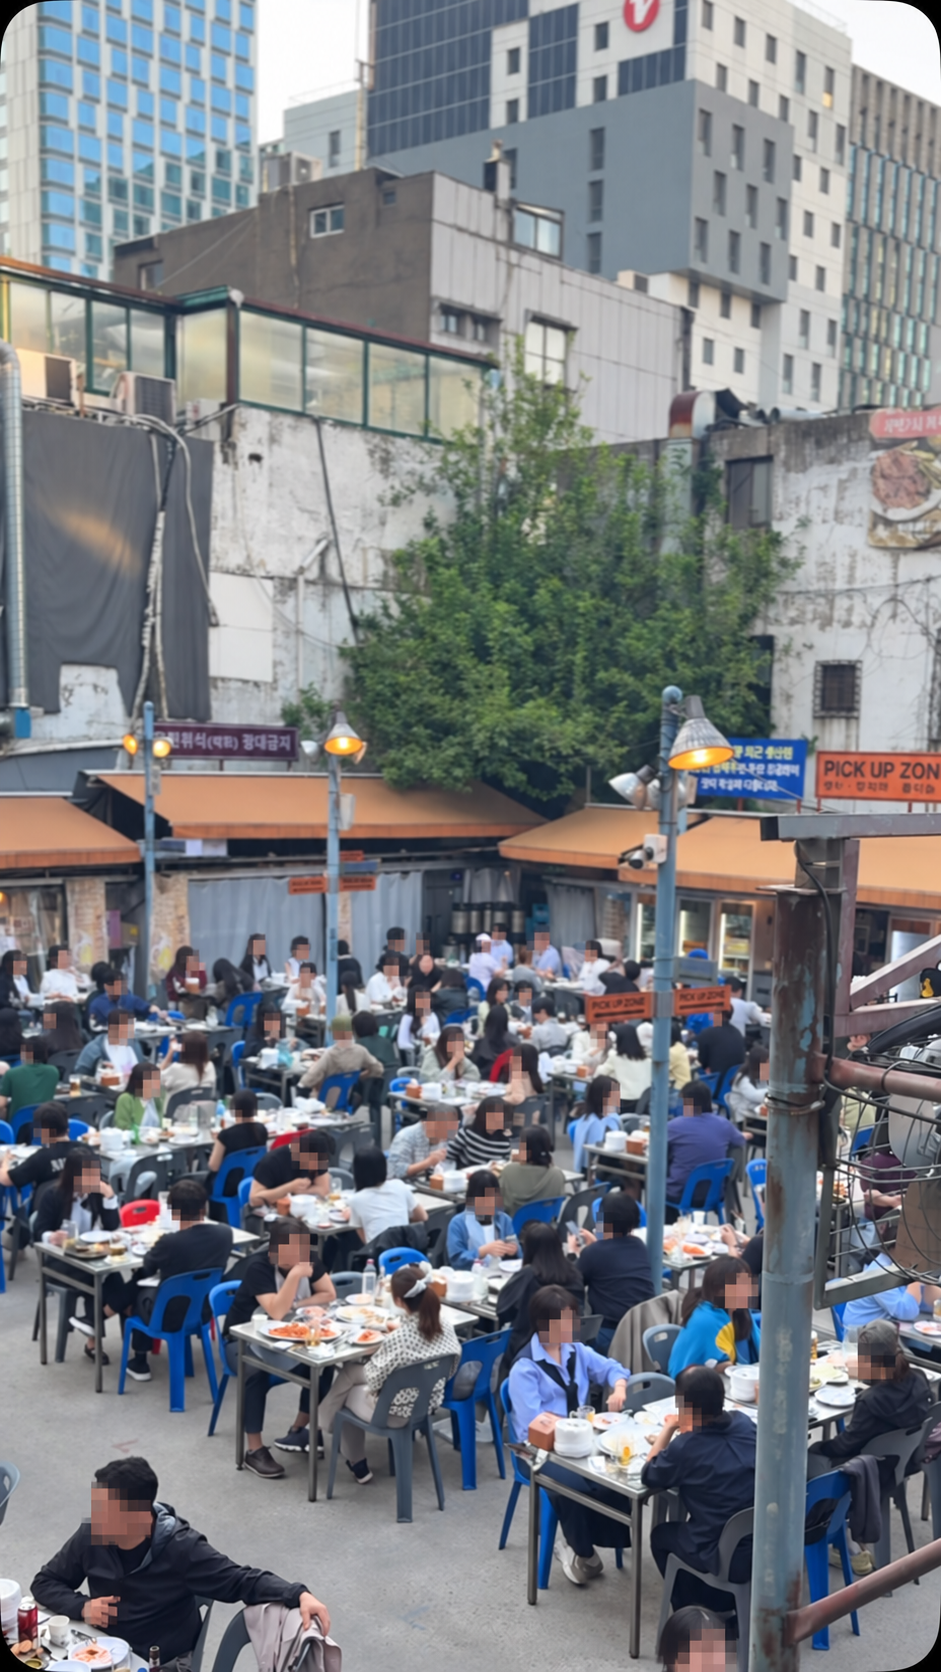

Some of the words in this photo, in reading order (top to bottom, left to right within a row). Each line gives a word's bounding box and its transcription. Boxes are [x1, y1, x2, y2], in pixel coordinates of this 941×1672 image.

[824, 760, 866, 778] PICK
[870, 761, 895, 779] UP
[592, 1000, 611, 1010] PICK
[613, 999, 623, 1009] UP
[624, 997, 645, 1007] ZONE
